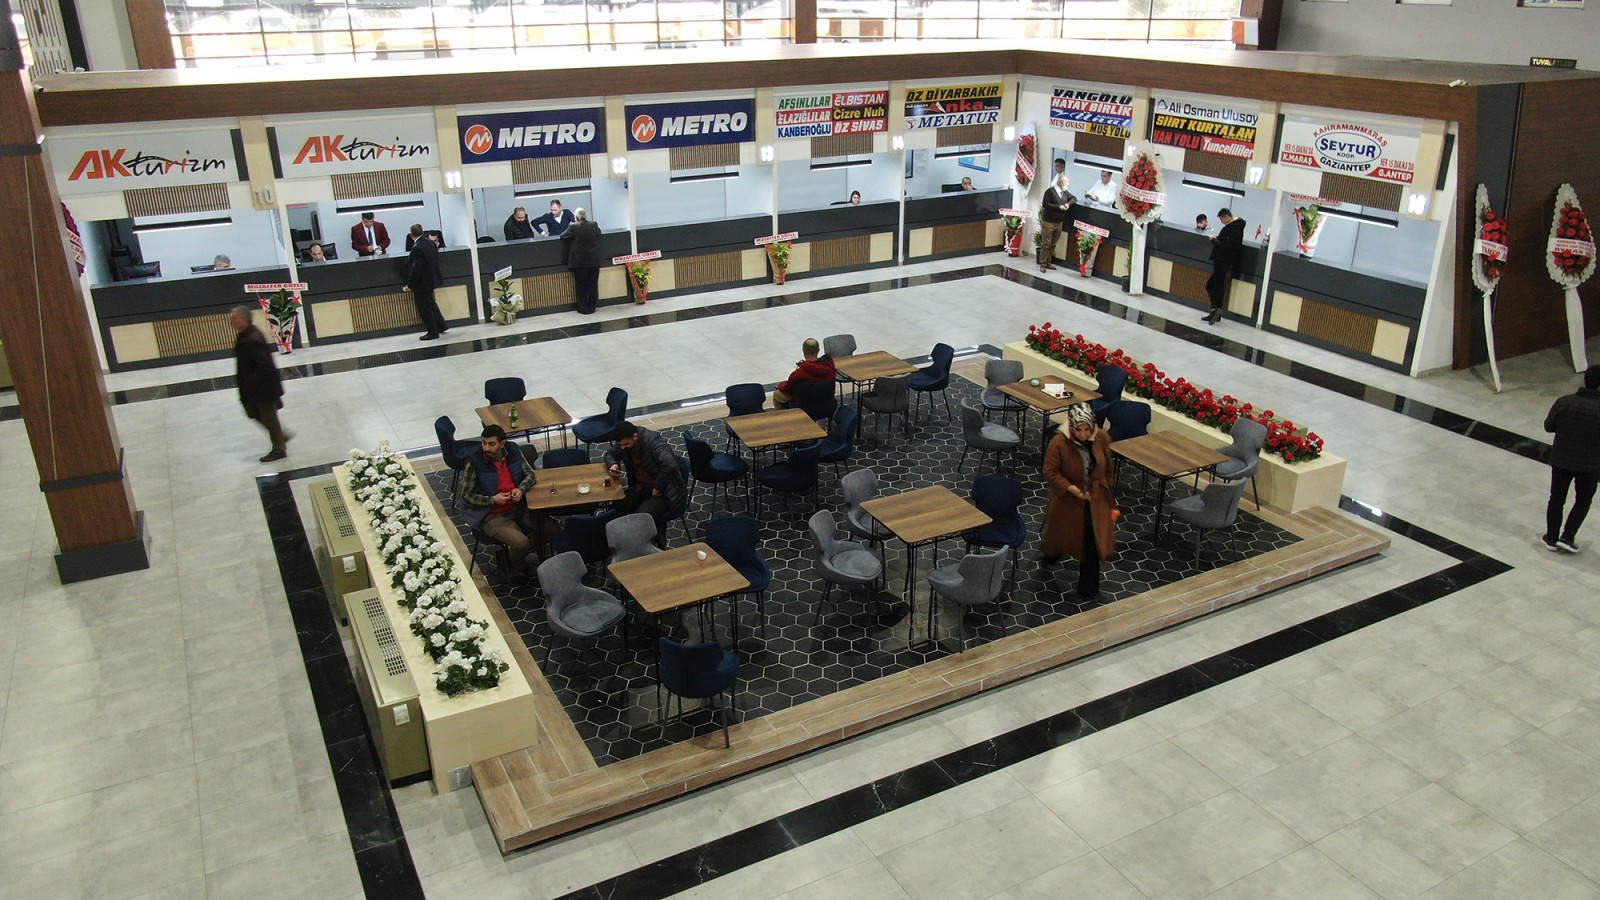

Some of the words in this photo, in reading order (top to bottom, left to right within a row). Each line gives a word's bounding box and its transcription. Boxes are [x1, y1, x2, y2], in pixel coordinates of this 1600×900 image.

[863, 106, 885, 118] Nuh
[1052, 98, 1088, 110] HATAY
[918, 111, 999, 128] METATUR
[1168, 102, 1181, 114] Ali
[1183, 103, 1219, 119] Osman
[1222, 108, 1259, 126] Ulusoy
[660, 111, 748, 137] METRO
[777, 123, 832, 138] KANBEROĞLU
[1187, 120, 1255, 139] KURTALAN
[497, 121, 596, 149] METRO
[1153, 129, 1173, 144] VAN
[1174, 133, 1200, 149] YOLU
[1319, 138, 1376, 158] SEVTUR
[612, 157, 627, 174] 12
[1282, 153, 1313, 165] K.MARAŞ
[445, 171, 462, 189] 11
[1249, 166, 1264, 184] 17
[1378, 169, 1412, 181] G.ANTEP
[255, 187, 273, 204] 10
